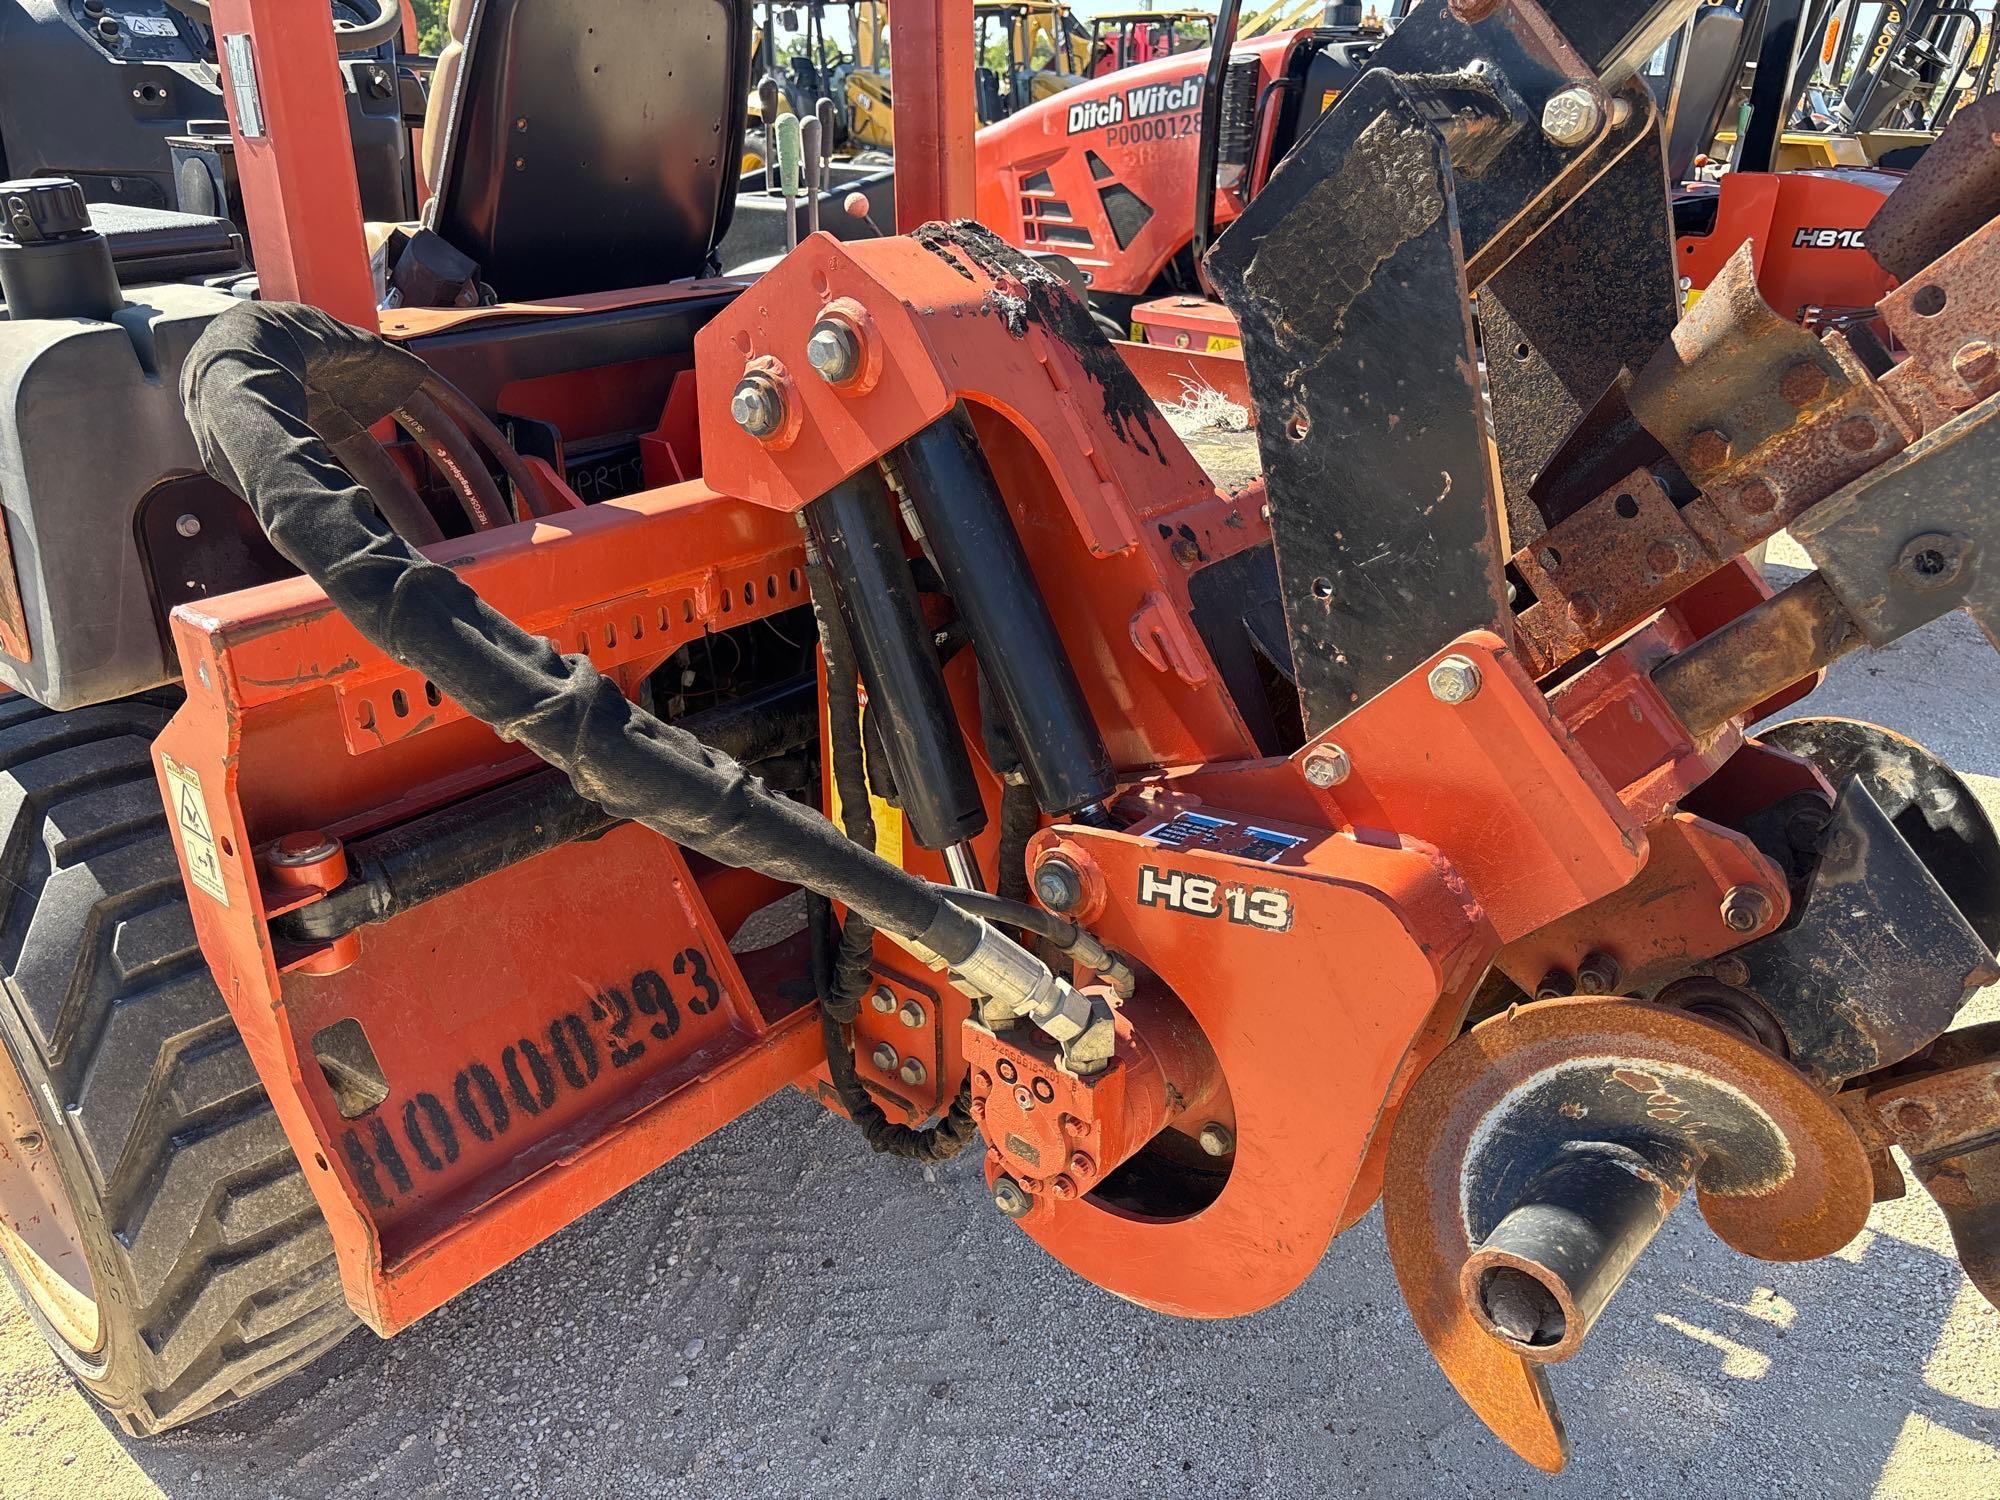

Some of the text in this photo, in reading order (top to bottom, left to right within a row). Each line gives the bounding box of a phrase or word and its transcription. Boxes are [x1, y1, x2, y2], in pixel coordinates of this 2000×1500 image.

[1068, 78, 1198, 134] Ditch Witch
[1141, 868, 1290, 928] H813
[340, 948, 720, 1208] H000293
